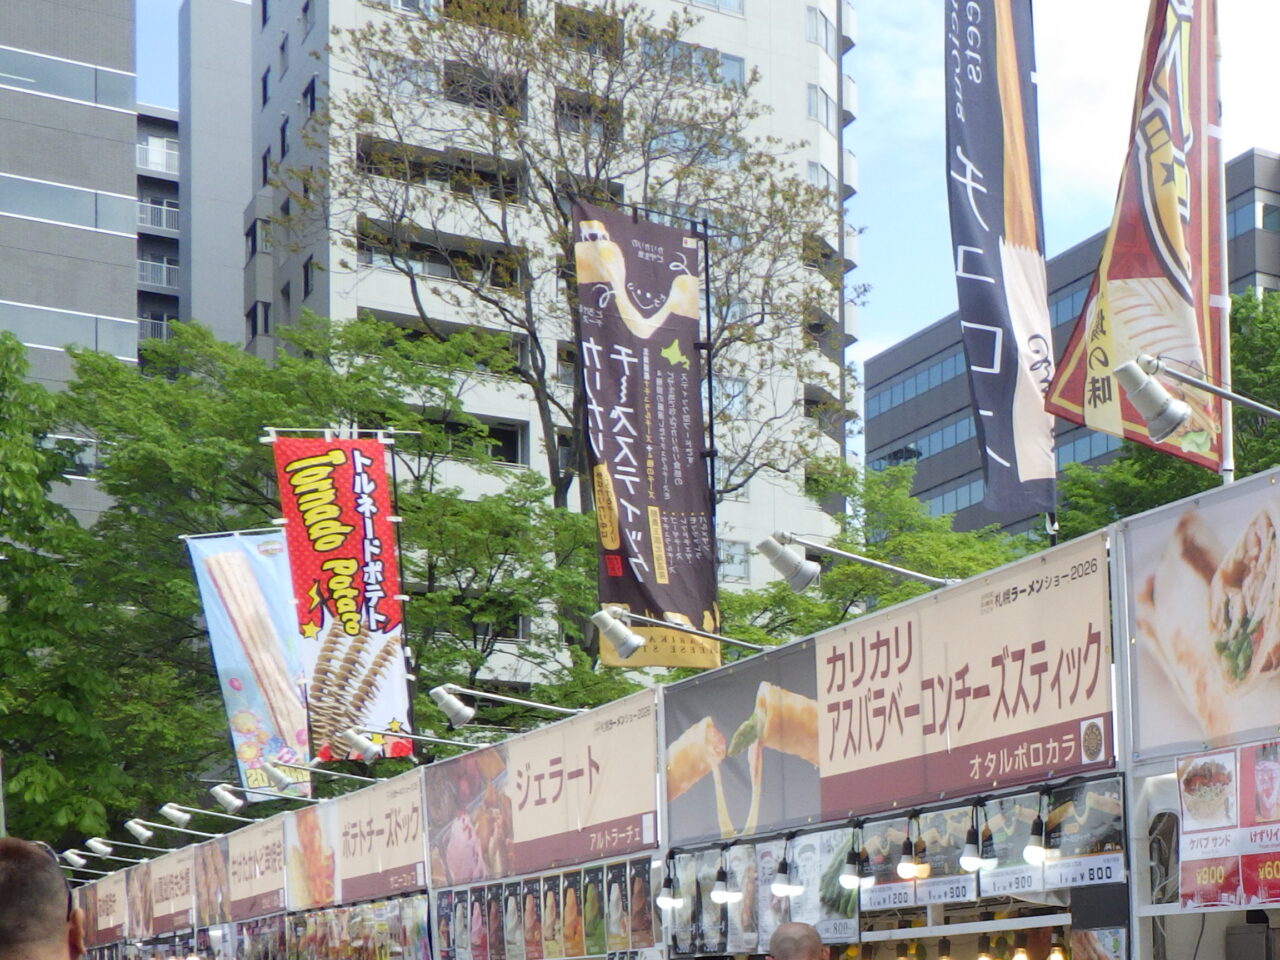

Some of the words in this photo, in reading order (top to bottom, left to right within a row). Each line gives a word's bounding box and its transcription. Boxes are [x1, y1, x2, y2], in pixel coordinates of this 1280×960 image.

[284, 448, 354, 552] Tornado
[825, 620, 914, 696] カリカリ
[516, 744, 600, 813] ジェラート
